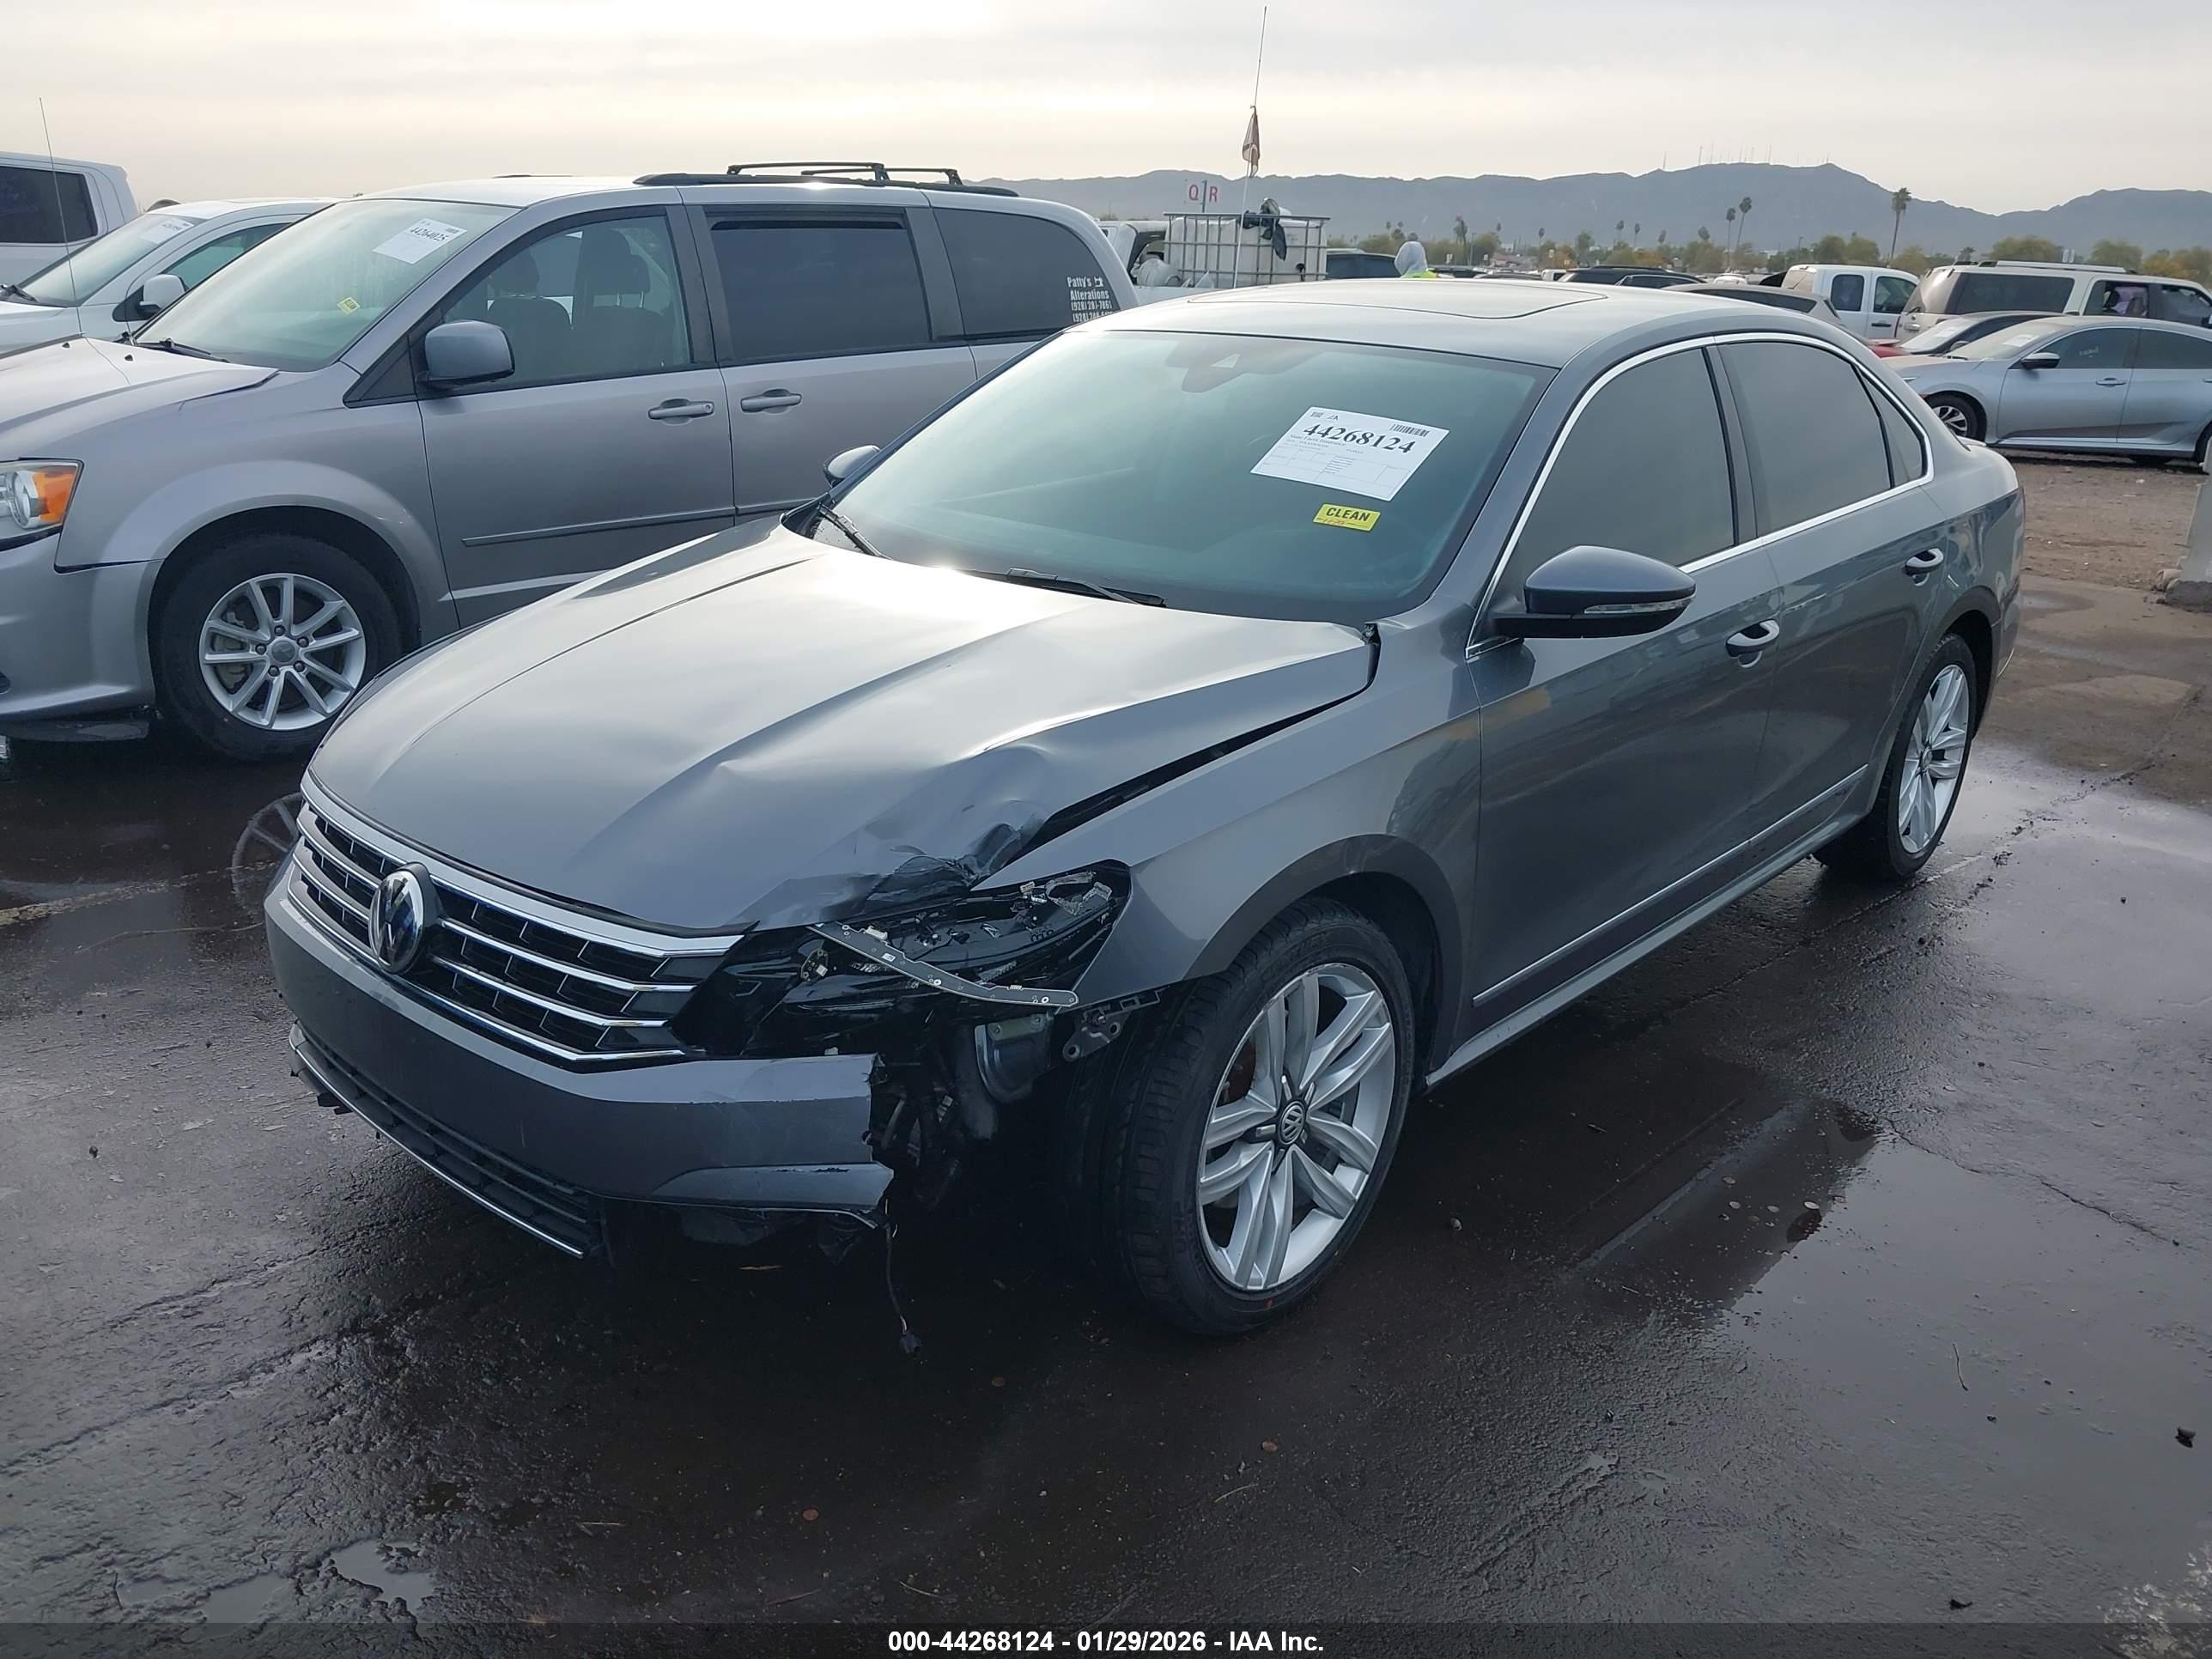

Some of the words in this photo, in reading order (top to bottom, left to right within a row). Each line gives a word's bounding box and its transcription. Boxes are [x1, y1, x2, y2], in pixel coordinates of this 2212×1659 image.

[1188, 184, 1199, 201] Q
[1209, 185, 1218, 203] R
[1066, 276, 1091, 288] Patty's
[1070, 289, 1109, 301] Alterations
[1304, 423, 1416, 453] 44268124
[1326, 507, 1370, 521] CLEAN
